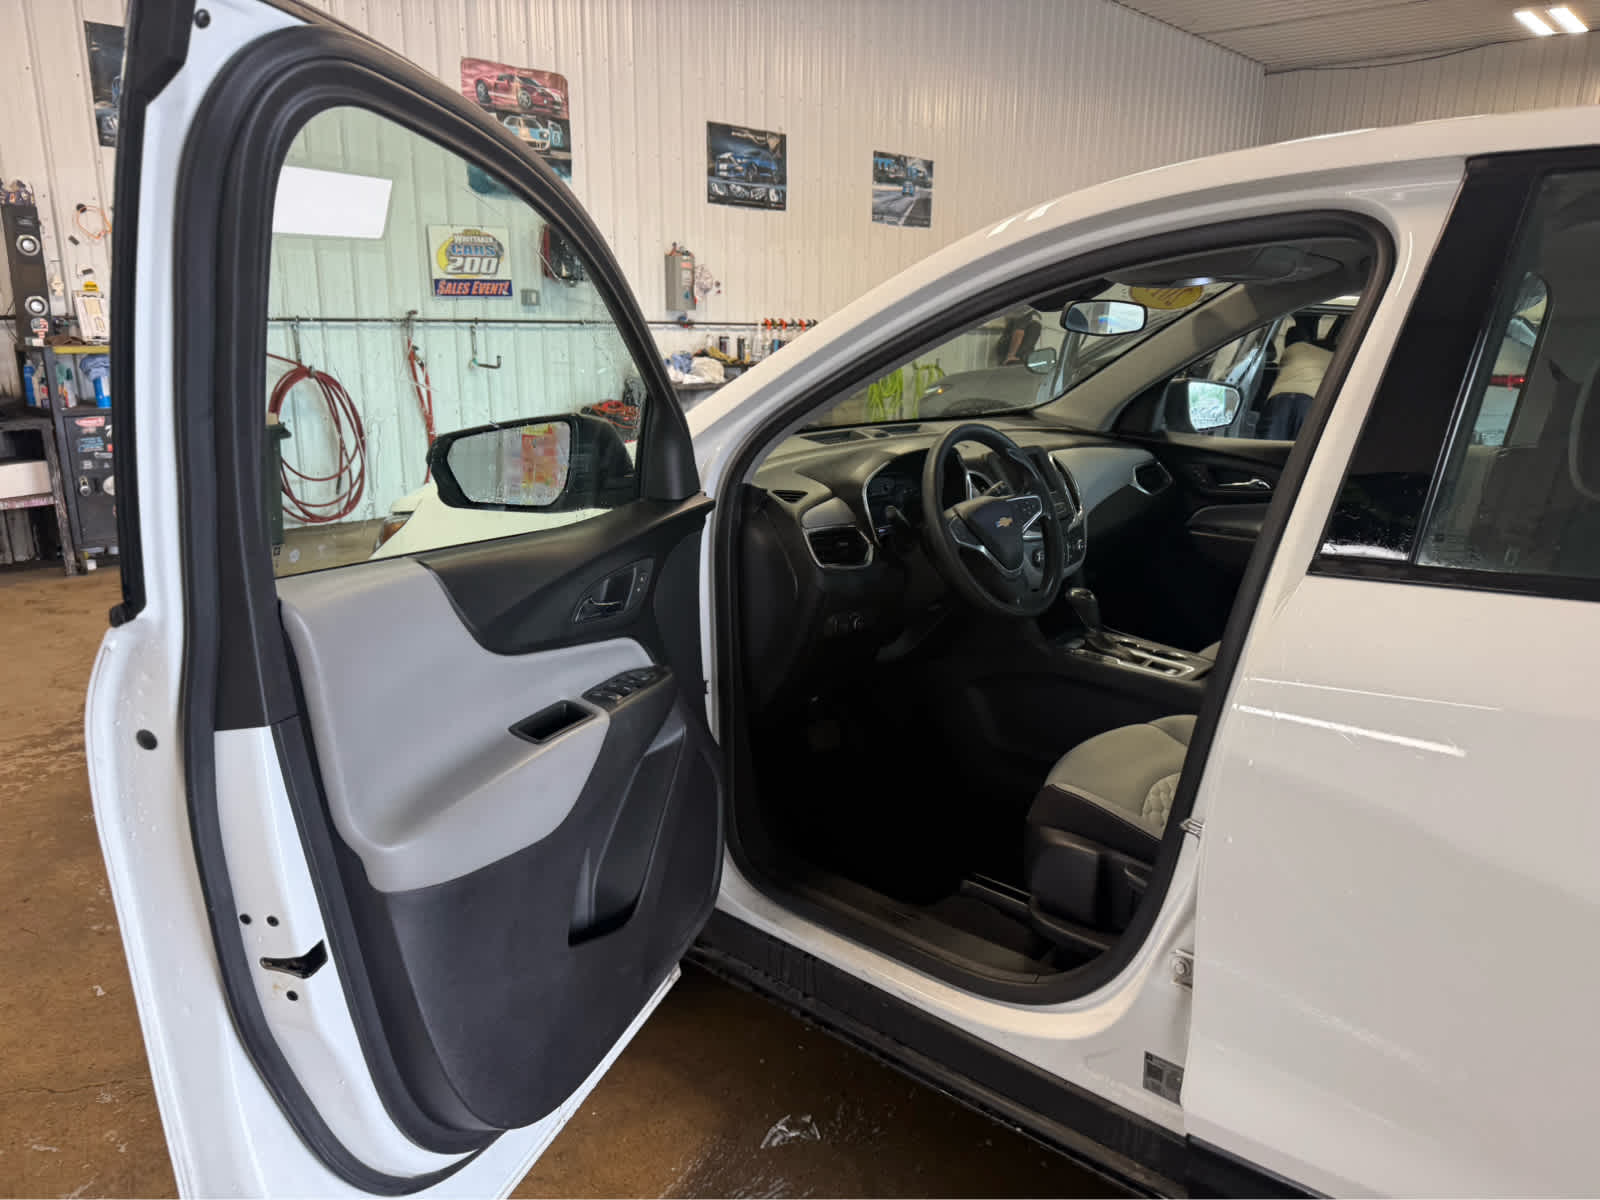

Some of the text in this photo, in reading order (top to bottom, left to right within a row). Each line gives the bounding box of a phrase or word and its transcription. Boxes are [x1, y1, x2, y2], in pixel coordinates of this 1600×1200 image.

[451, 245, 496, 256] CARS
[447, 256, 498, 274] 200
[438, 280, 509, 295] SALES EVENT!
